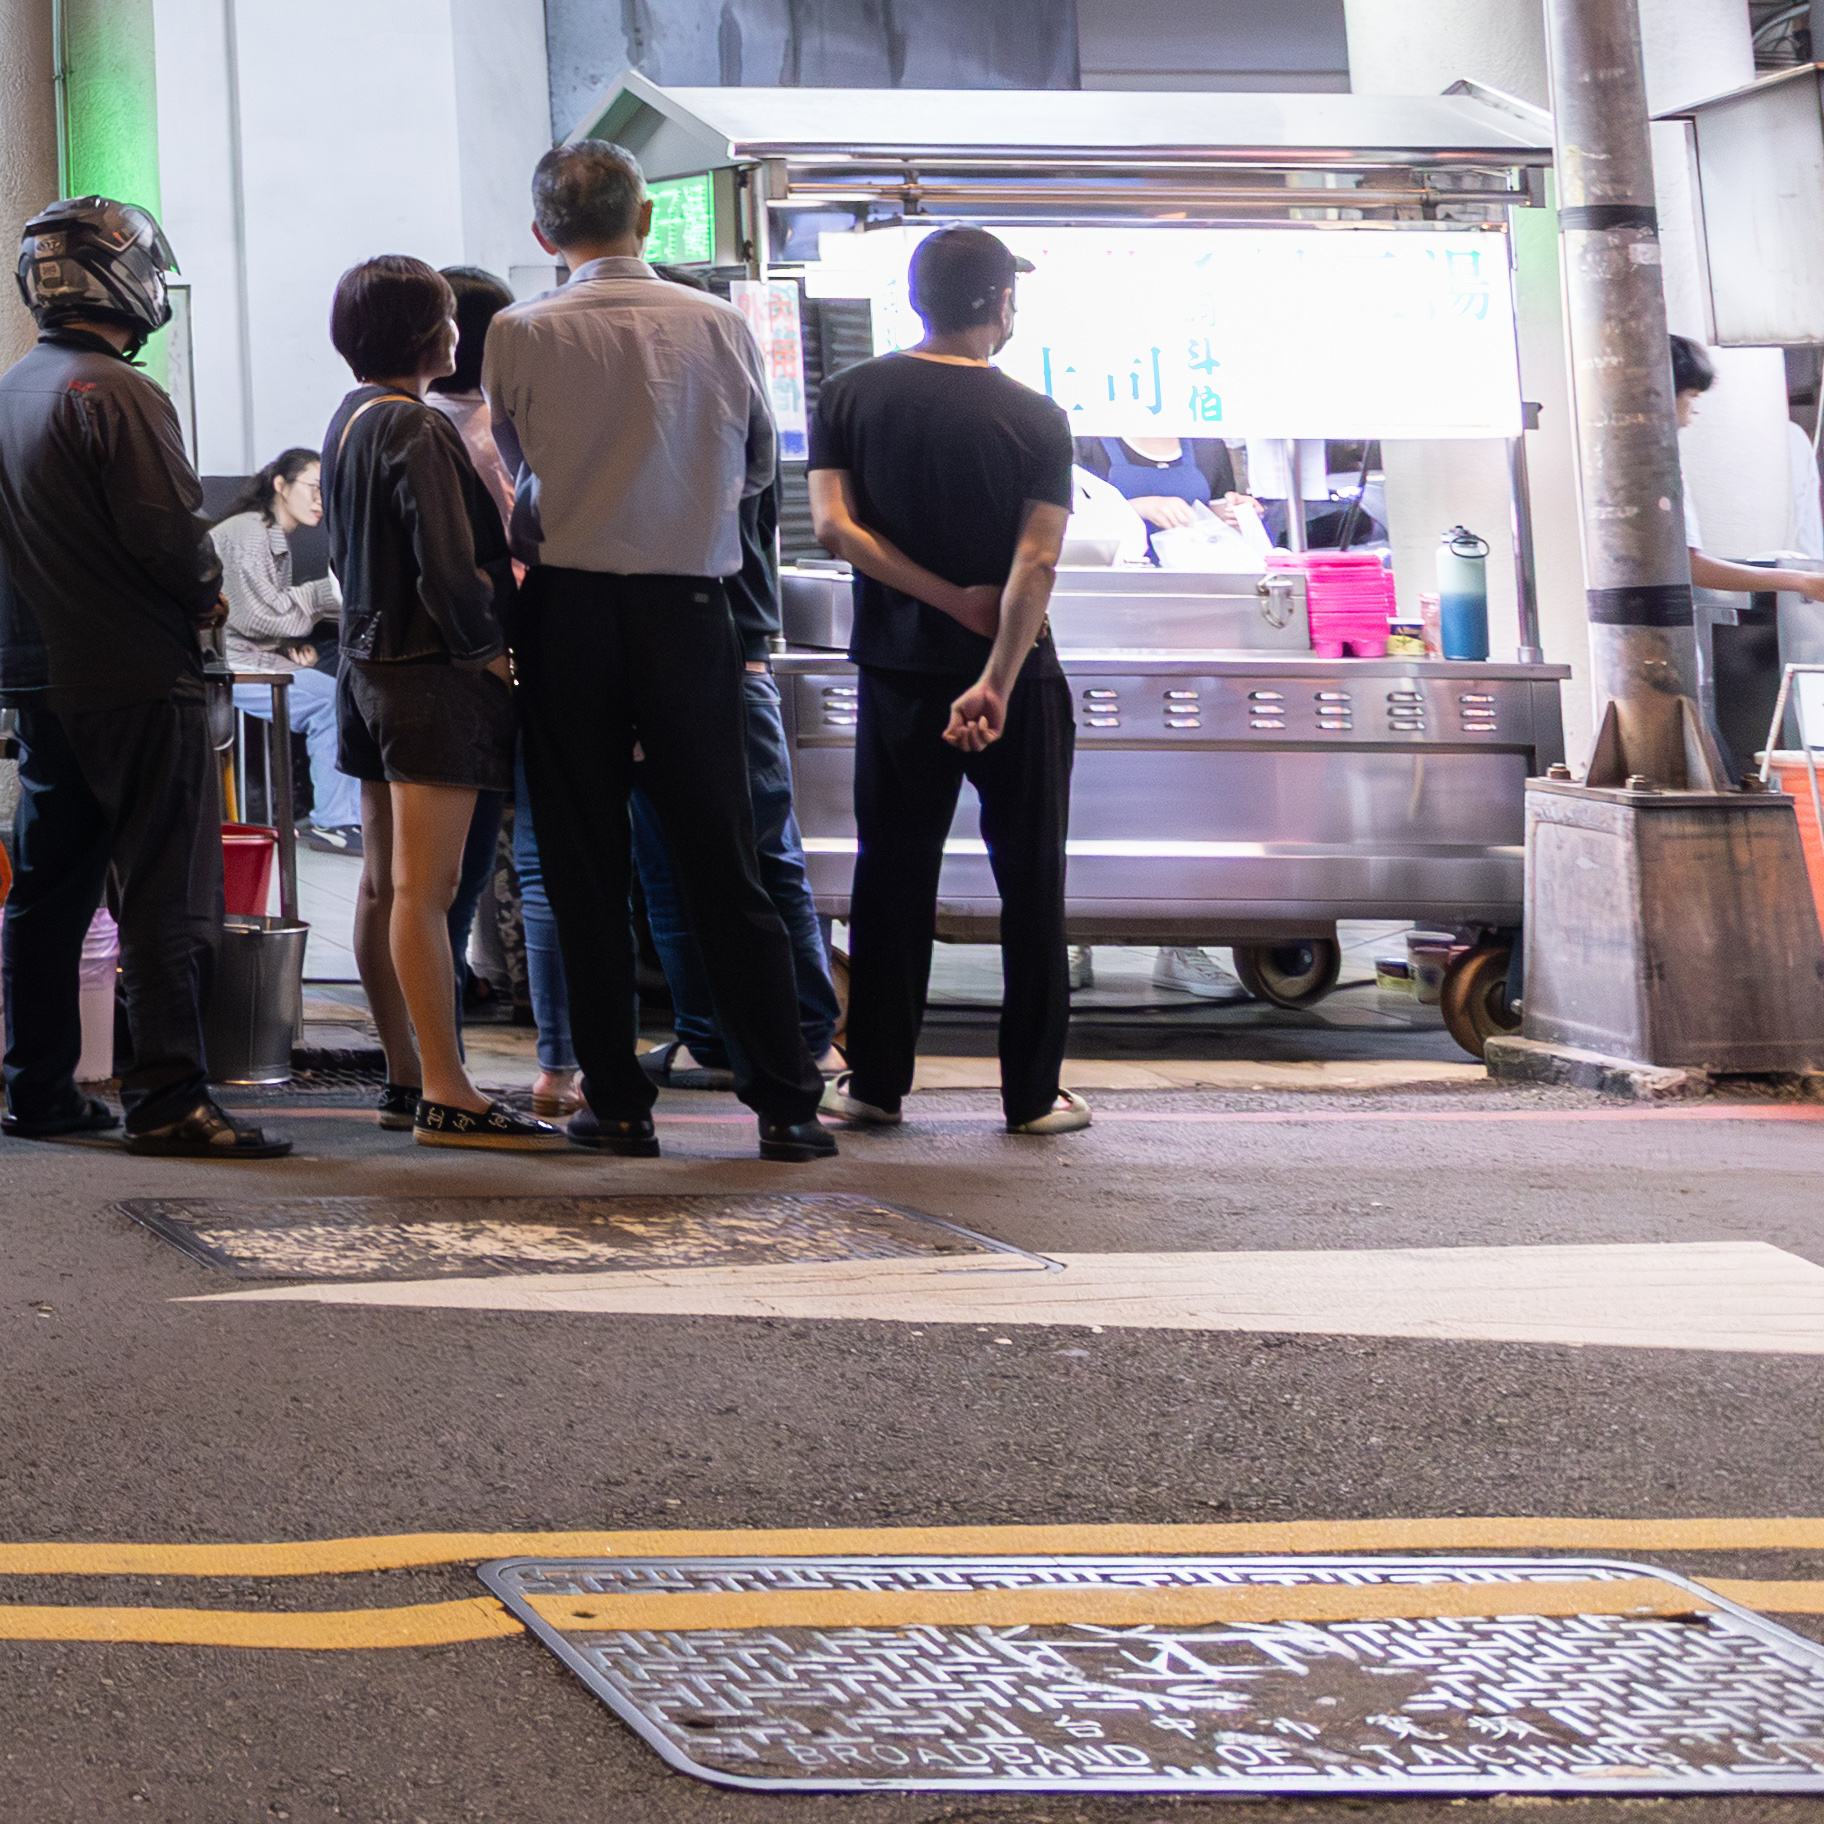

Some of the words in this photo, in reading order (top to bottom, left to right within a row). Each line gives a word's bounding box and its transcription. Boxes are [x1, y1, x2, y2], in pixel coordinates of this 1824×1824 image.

[785, 1744, 1152, 1767] BROADBAND
[1214, 1744, 1295, 1766] OF
[1358, 1743, 1687, 1766] TAICHUNG
